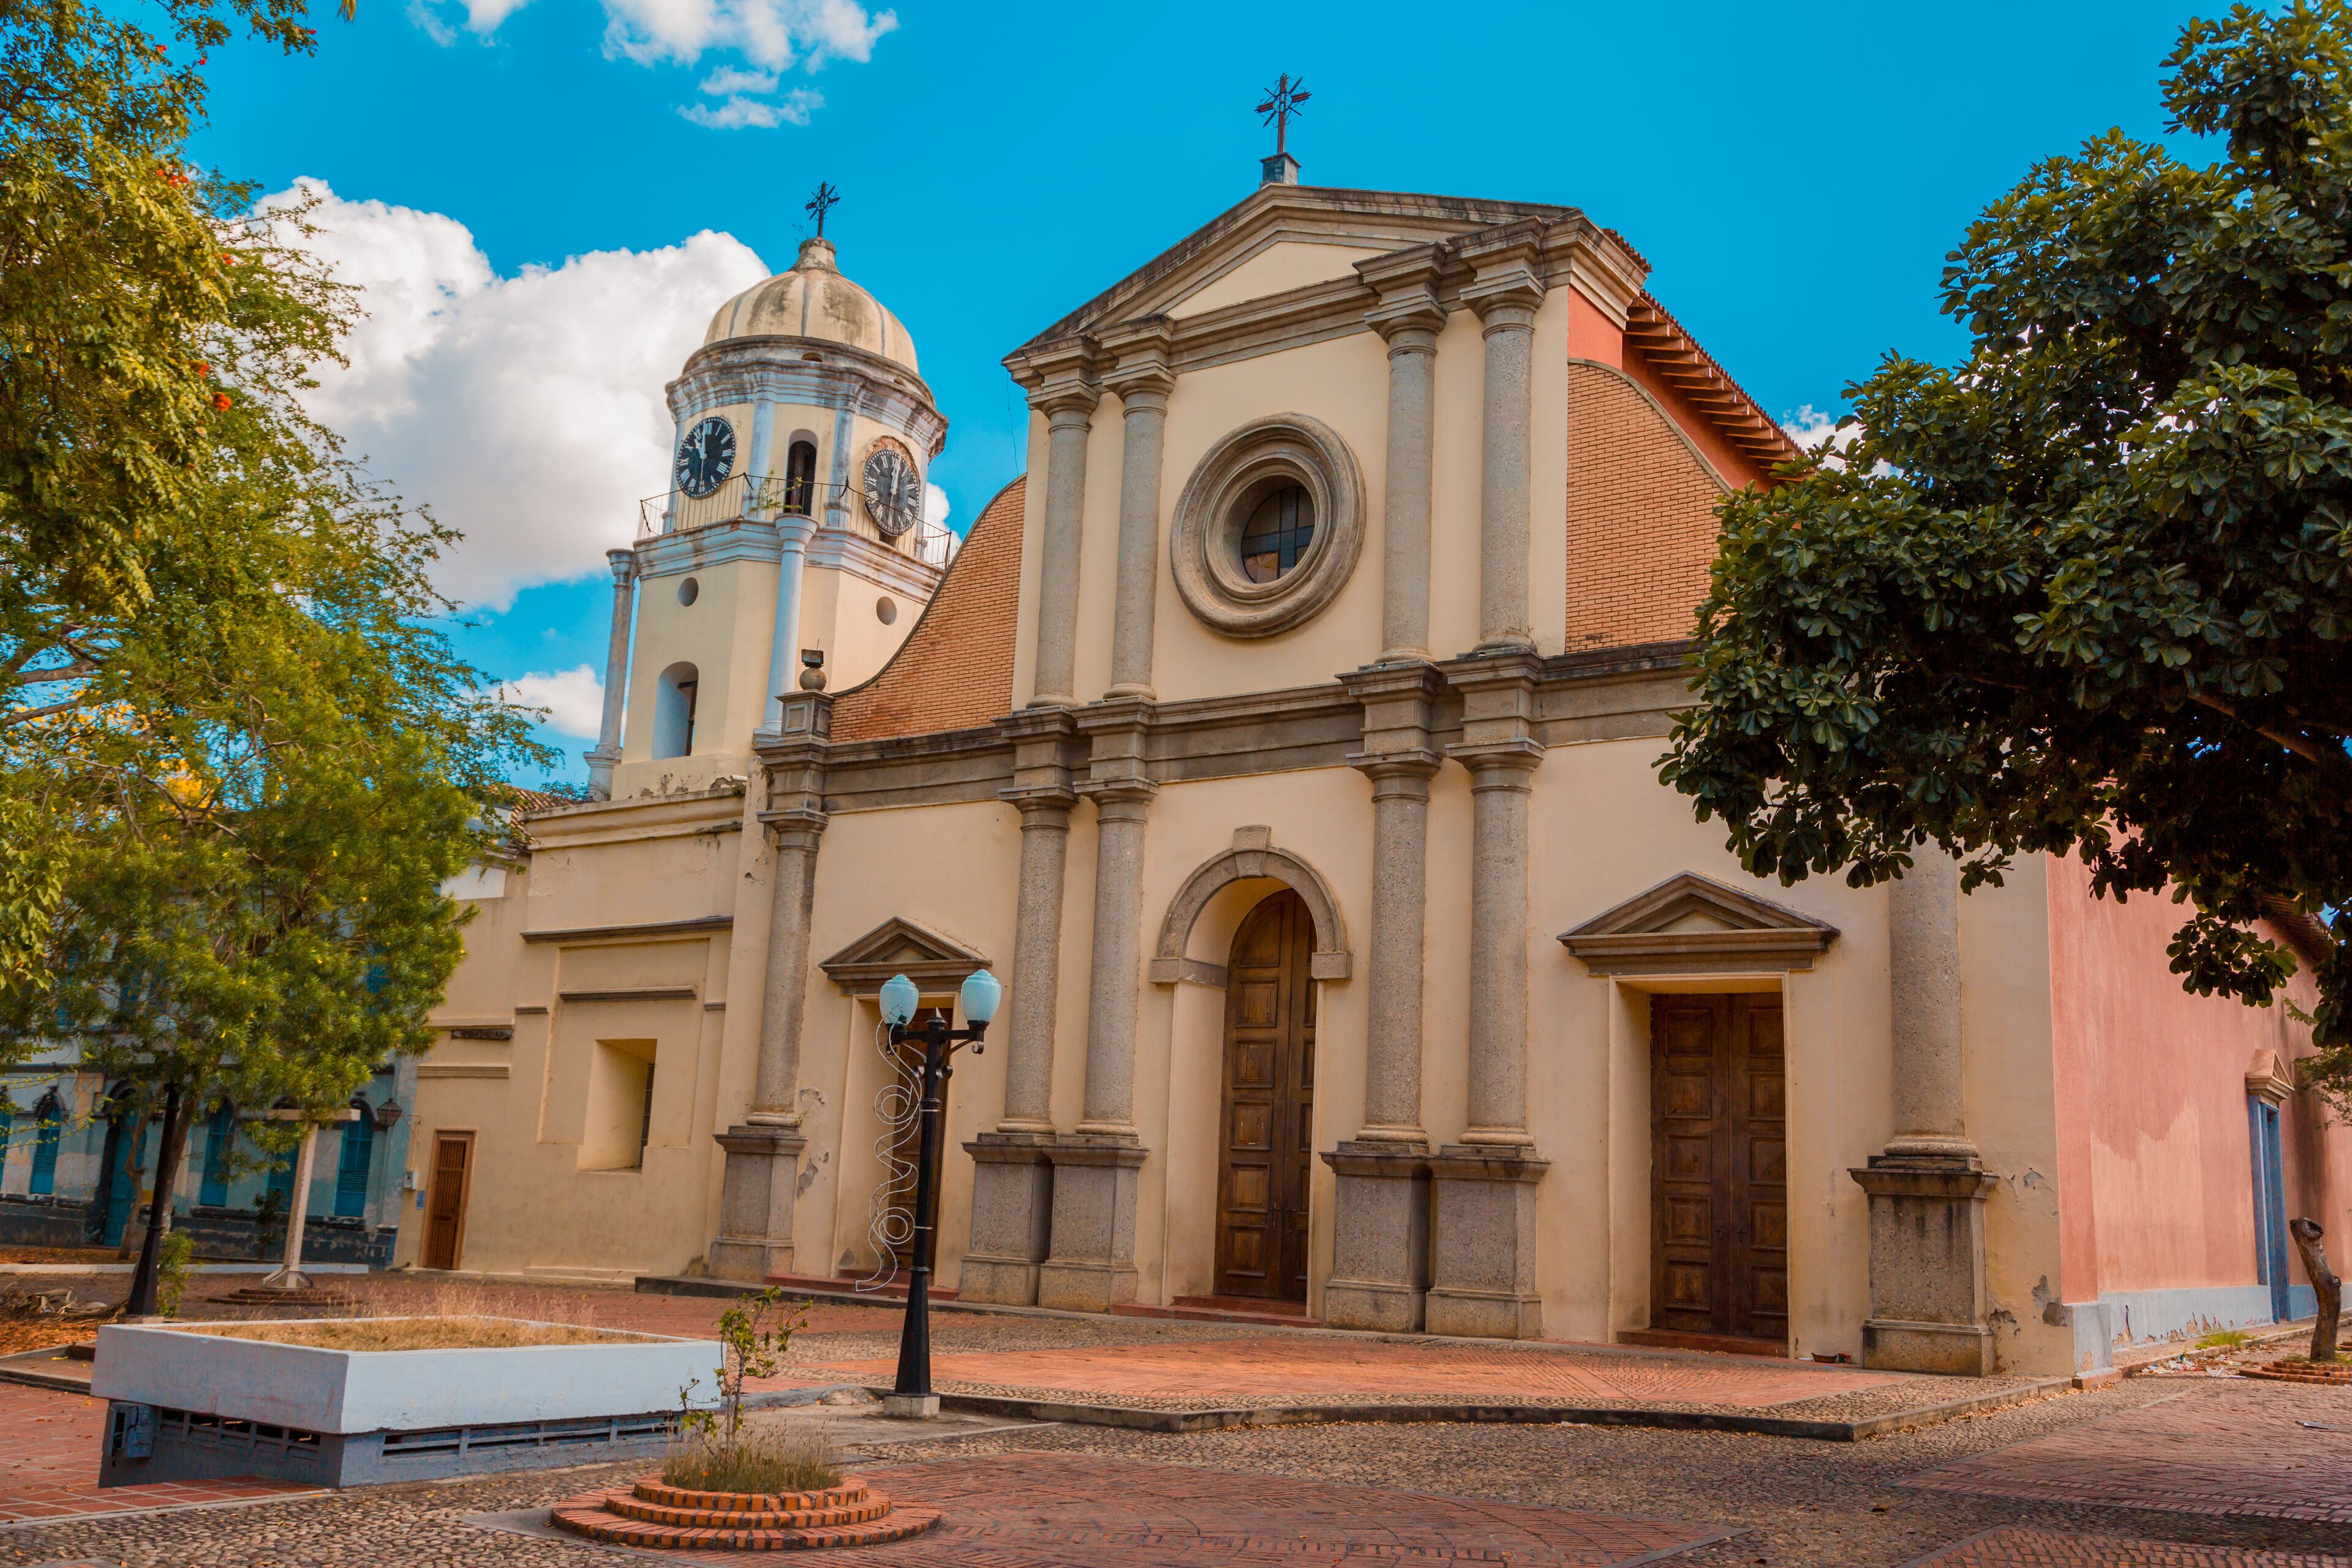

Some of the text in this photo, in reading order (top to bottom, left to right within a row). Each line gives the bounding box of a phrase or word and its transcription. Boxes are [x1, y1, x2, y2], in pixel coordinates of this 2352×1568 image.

[721, 434, 731, 444] II
[684, 443, 694, 451] X
[907, 497, 917, 507] III
